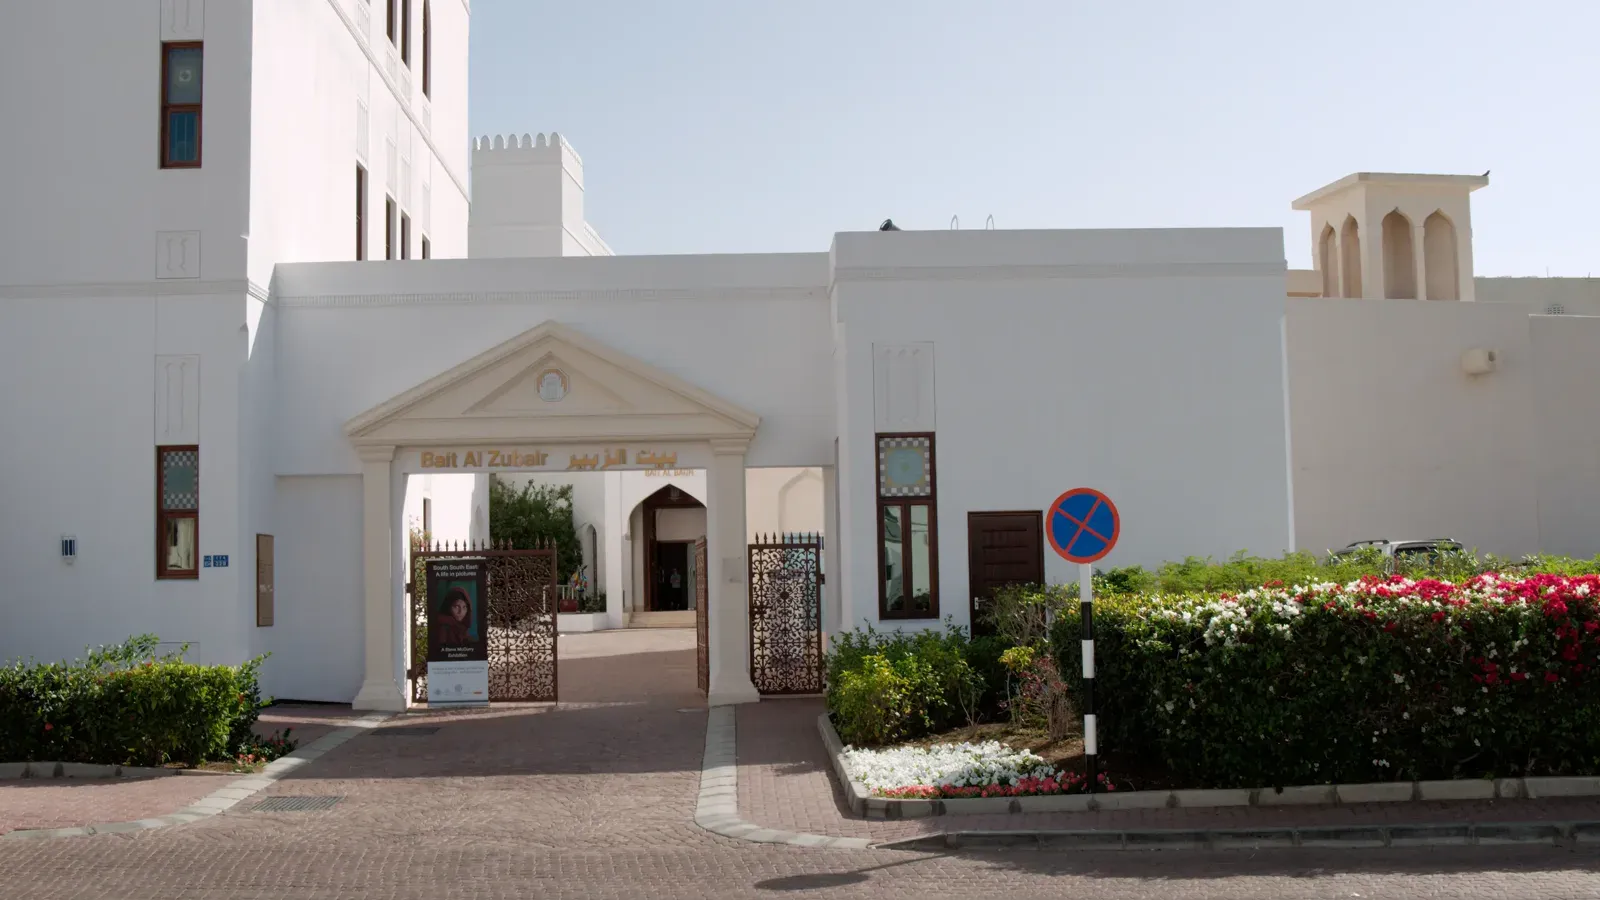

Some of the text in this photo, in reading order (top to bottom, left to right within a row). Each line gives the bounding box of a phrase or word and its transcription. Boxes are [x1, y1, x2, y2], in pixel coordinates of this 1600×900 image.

[420, 450, 549, 468] Bait Al Zubair
[566, 448, 677, 470] بيت الزبير
